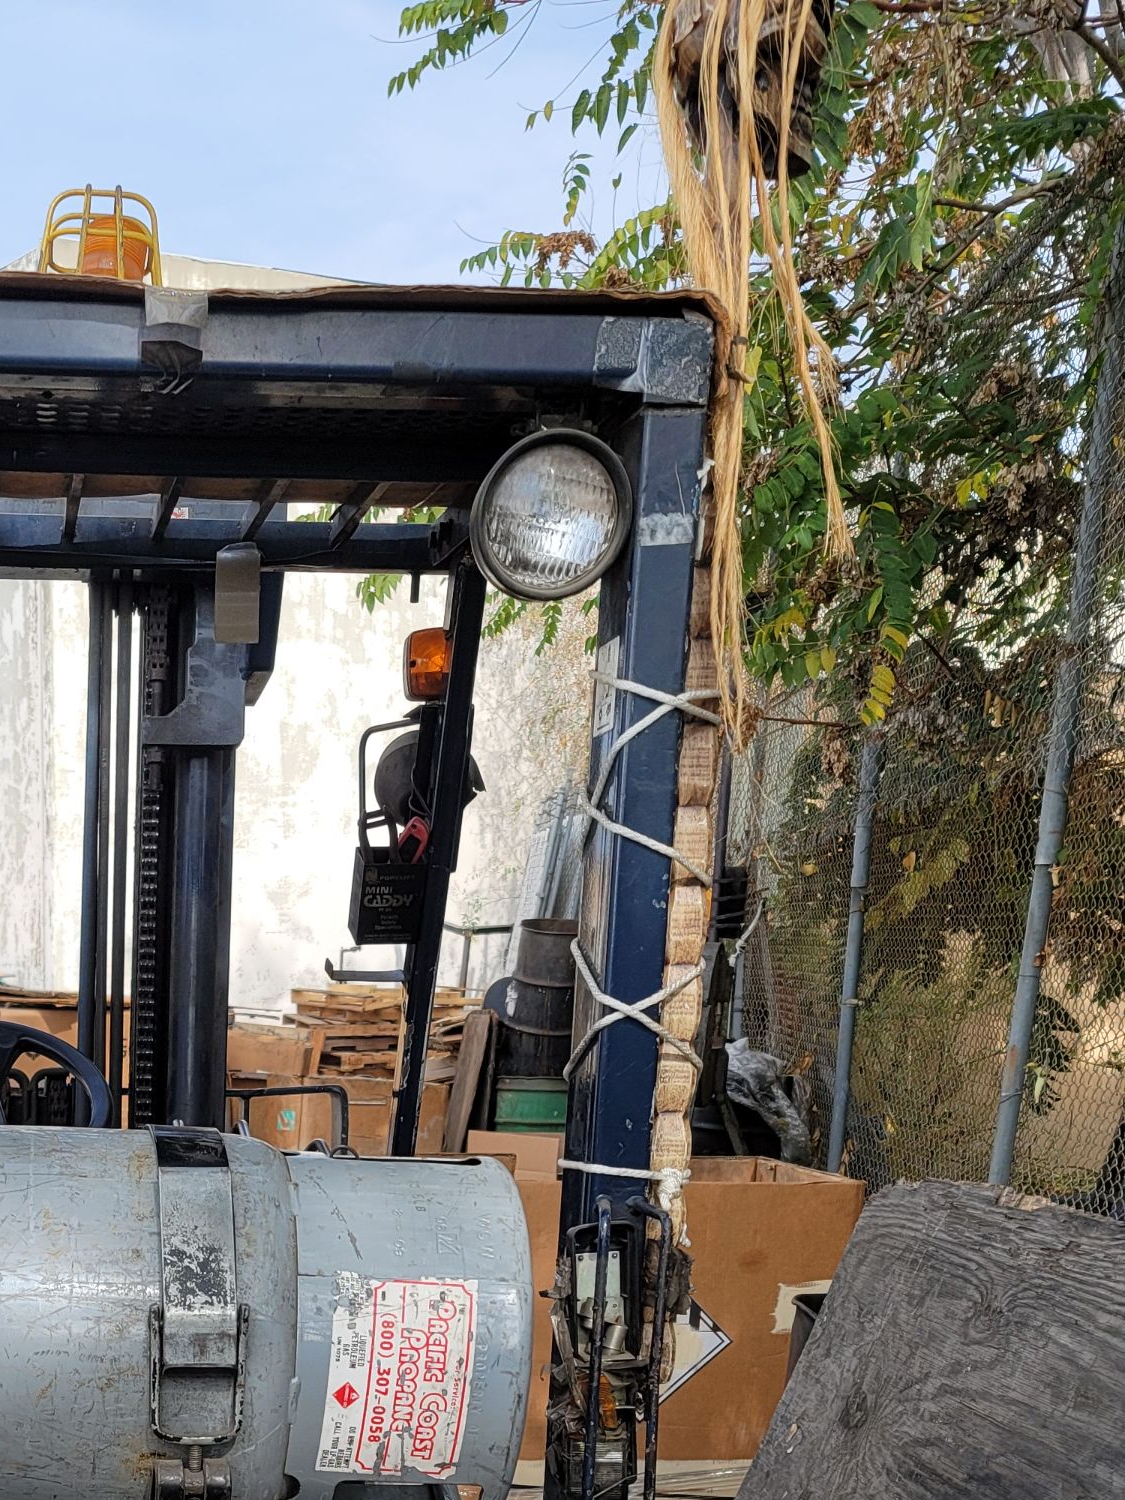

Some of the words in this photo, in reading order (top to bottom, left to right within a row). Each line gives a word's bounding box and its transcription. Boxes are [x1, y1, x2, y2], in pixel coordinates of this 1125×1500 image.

[363, 894, 414, 908] CADDY
[366, 886, 393, 894] MINI
[349, 1332, 360, 1369] PETROLEUM
[357, 1335, 367, 1367] LIQUEFIED
[379, 1313, 398, 1359] (800)
[424, 1300, 457, 1383] PACIFIC
[389, 1327, 427, 1434] PROPANE
[451, 1377, 461, 1409] Service:
[367, 1367, 392, 1443] 307-0058
[411, 1392, 448, 1460] COAST
